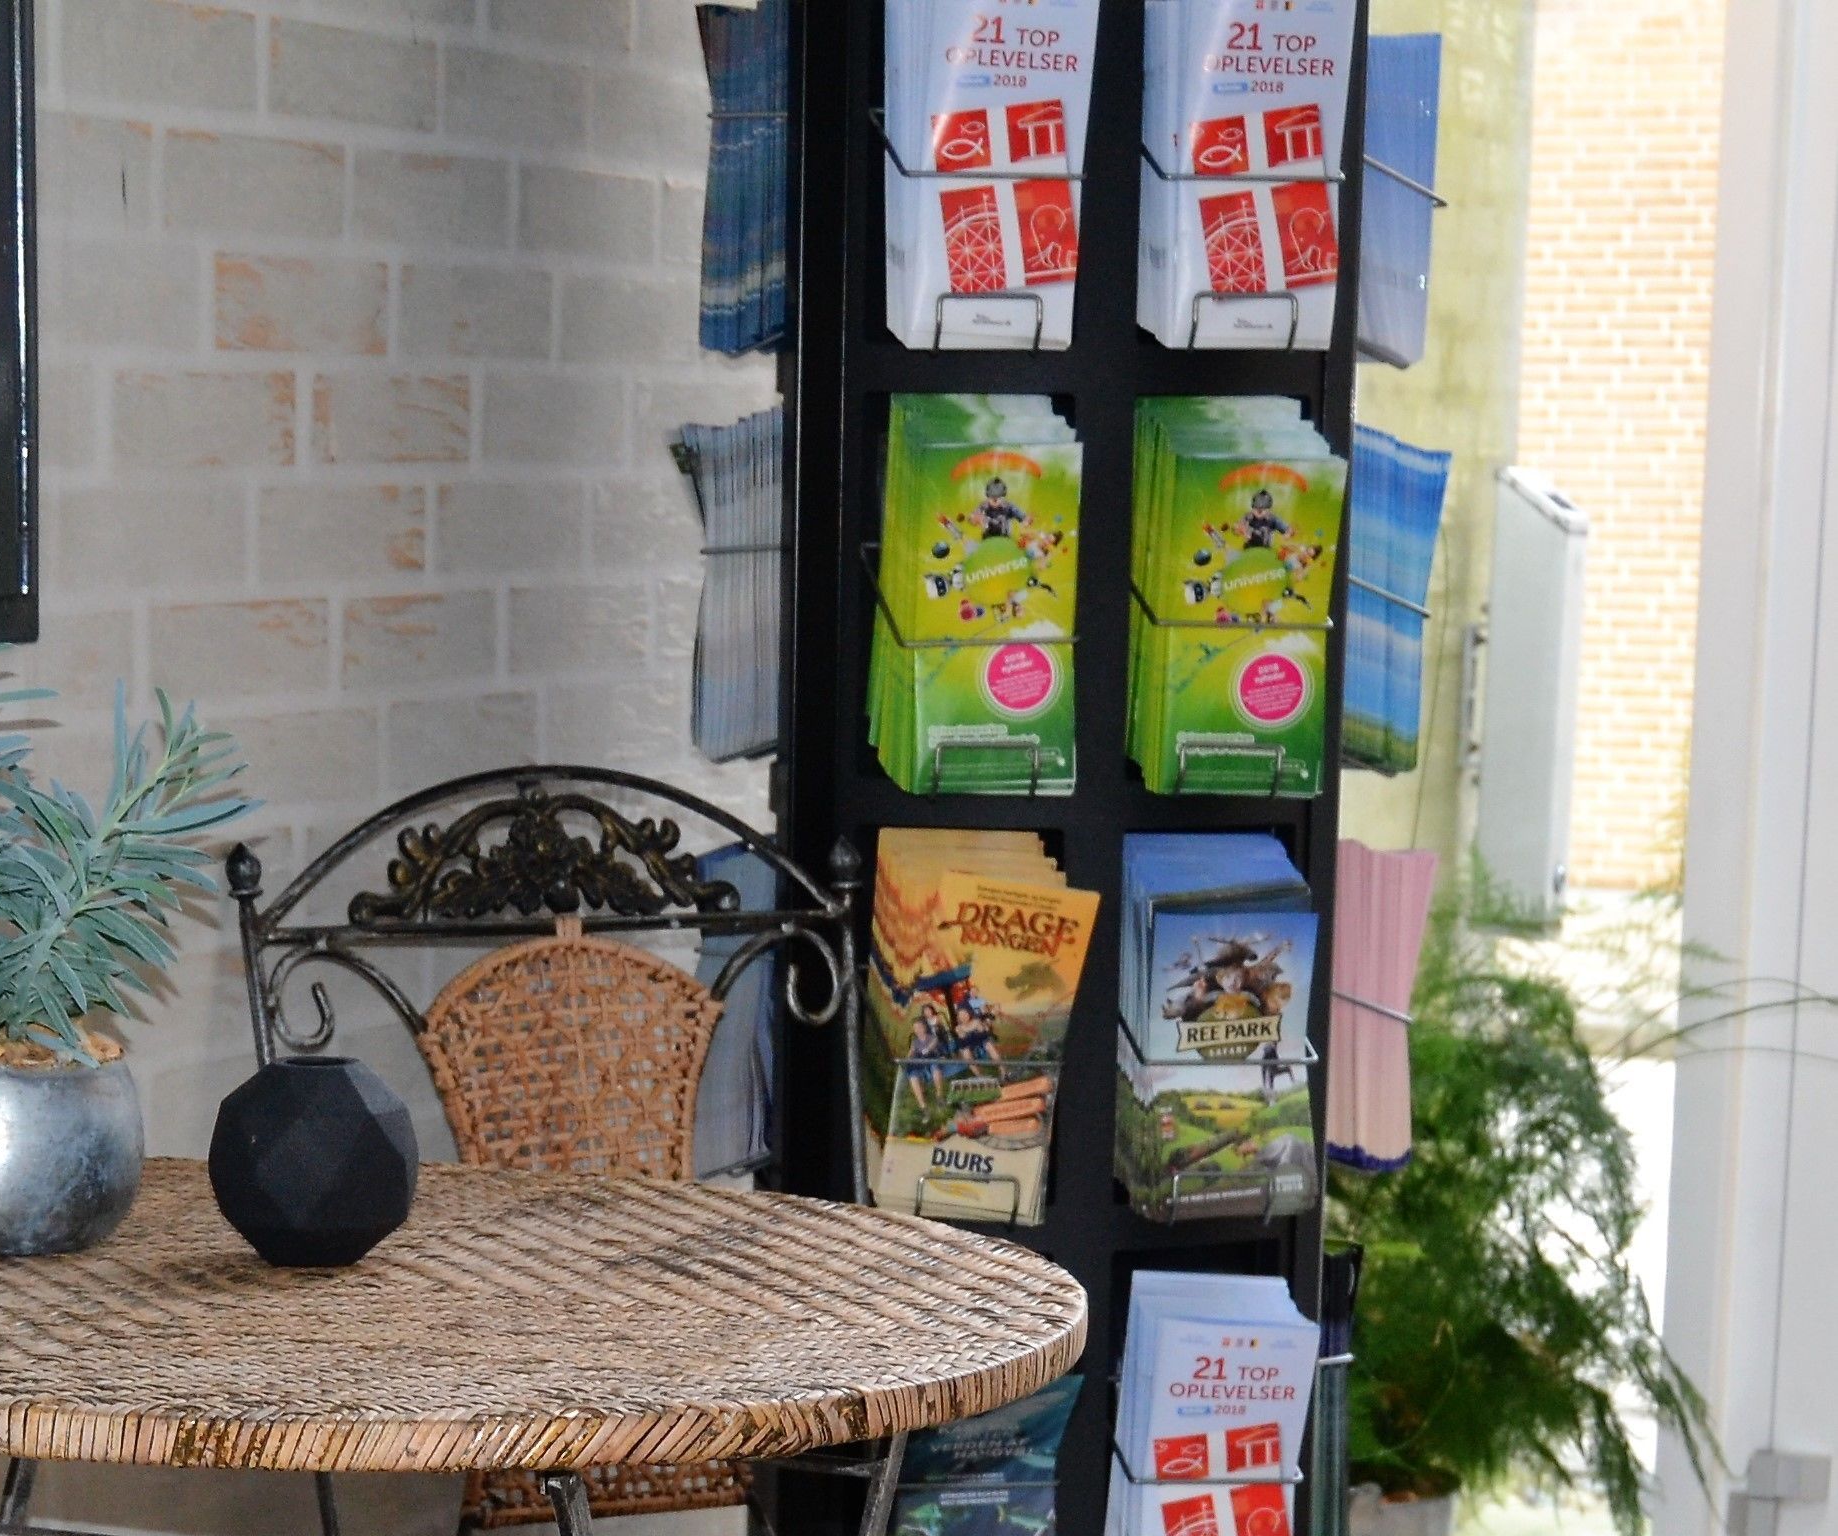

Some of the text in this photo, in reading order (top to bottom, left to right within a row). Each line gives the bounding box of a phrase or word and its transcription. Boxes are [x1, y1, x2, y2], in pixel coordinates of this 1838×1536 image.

[972, 15, 1059, 47] 21 TOP
[1226, 21, 1316, 52] 21 TOP
[993, 74, 1027, 88] 2018
[1250, 80, 1284, 93] 2018
[965, 557, 1027, 583] universe
[1224, 567, 1286, 592] universe
[955, 902, 1080, 944] DRAGE
[1187, 1021, 1271, 1042] REE PARK
[931, 1147, 995, 1174] DJURS
[1192, 1356, 1279, 1381] 21 TOP
[1169, 1382, 1295, 1400] OPLEVELSER
[1214, 1405, 1246, 1416] 2018
